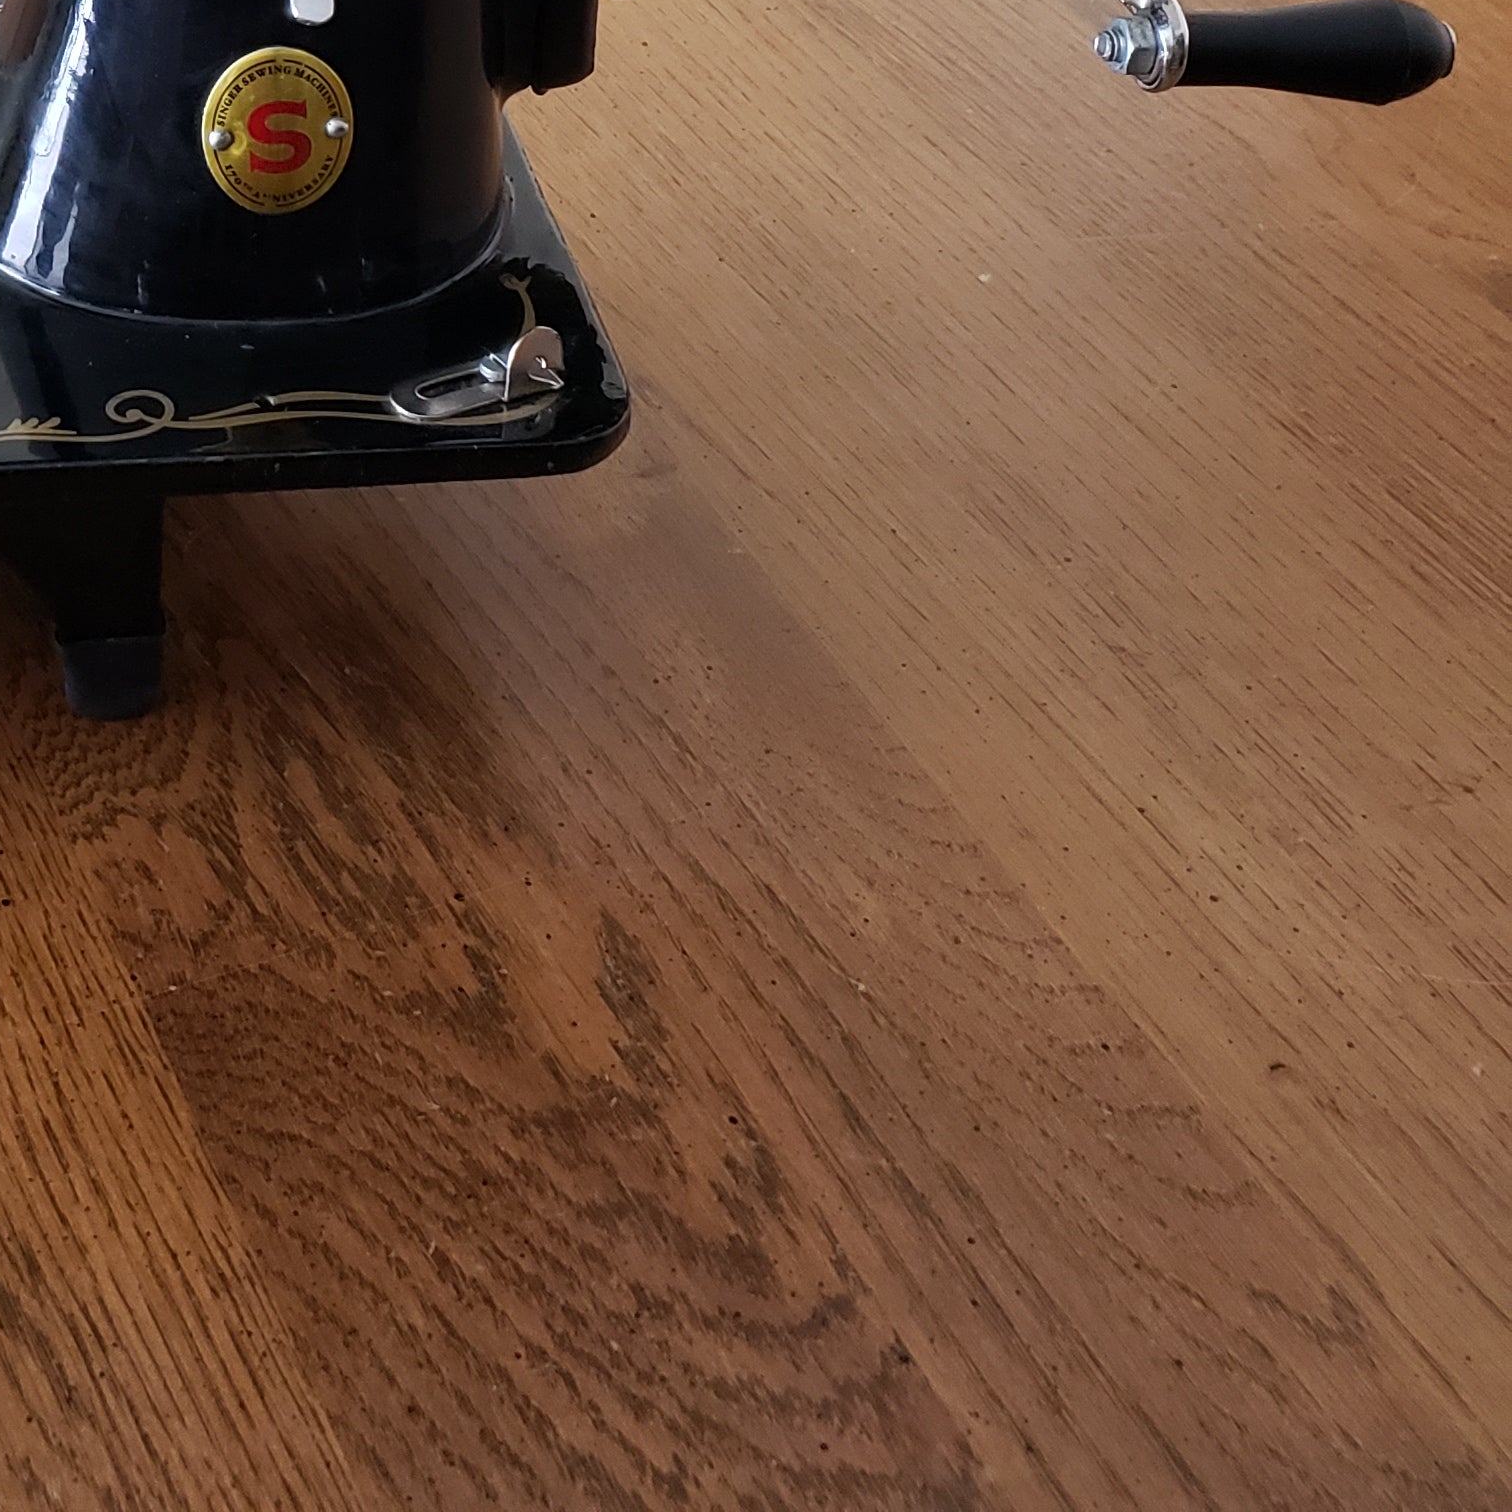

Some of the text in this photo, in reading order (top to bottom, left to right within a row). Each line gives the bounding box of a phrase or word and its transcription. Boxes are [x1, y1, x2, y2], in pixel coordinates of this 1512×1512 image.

[216, 83, 243, 128] SINGER
[242, 64, 292, 87] SEWING
[246, 99, 313, 175] S
